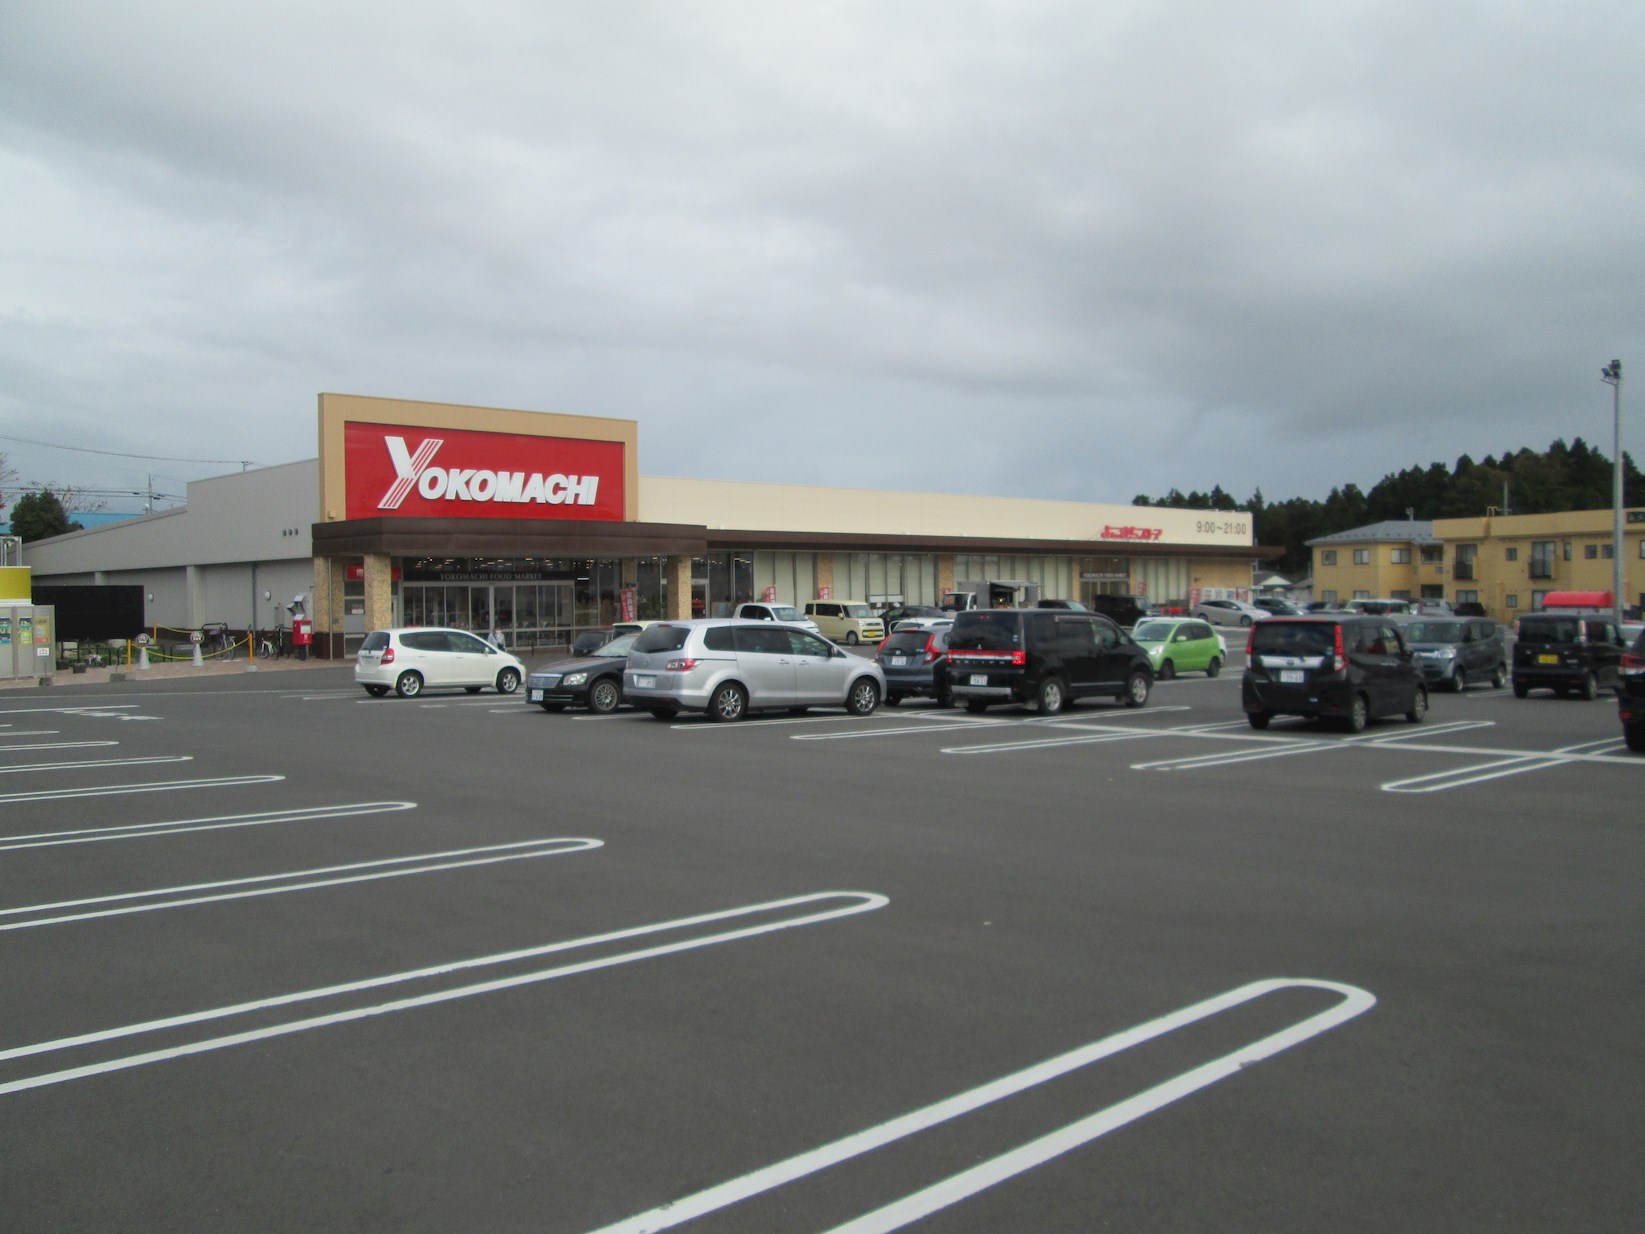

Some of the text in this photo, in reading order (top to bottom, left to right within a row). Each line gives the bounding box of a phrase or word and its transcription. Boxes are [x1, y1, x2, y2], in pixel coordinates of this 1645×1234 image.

[377, 435, 600, 510] YOKOMACHI
[439, 572, 543, 582] YOKOMACHI FOOD MARKET
